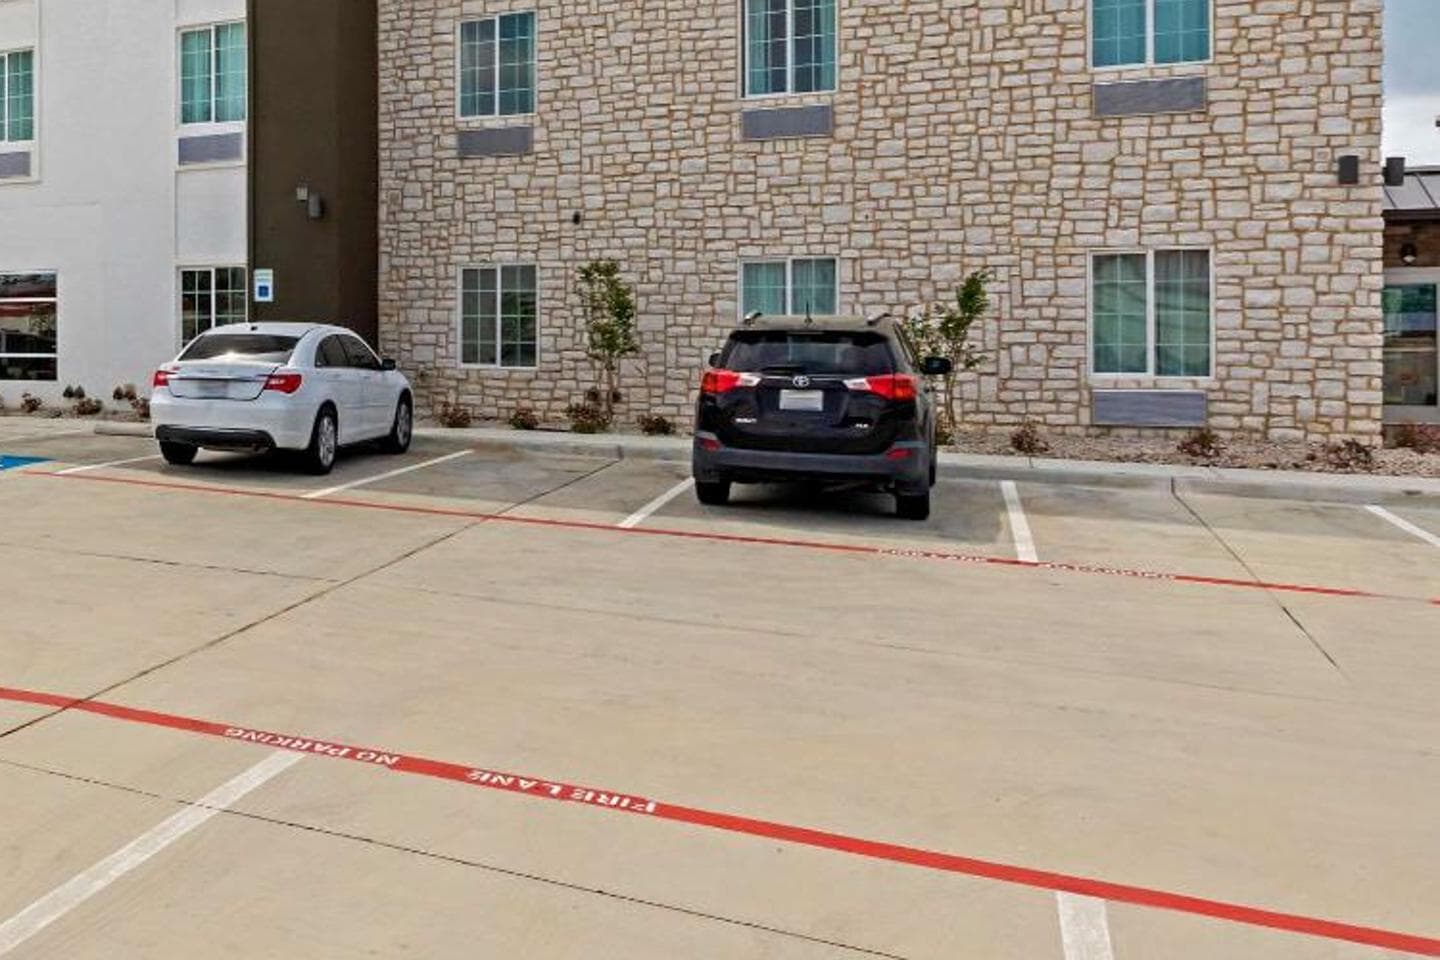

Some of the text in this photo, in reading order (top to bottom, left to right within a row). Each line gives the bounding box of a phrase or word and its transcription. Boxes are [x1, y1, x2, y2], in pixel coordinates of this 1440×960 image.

[225, 727, 402, 765] NO PARKING
[468, 770, 657, 813] FIRE LANE
